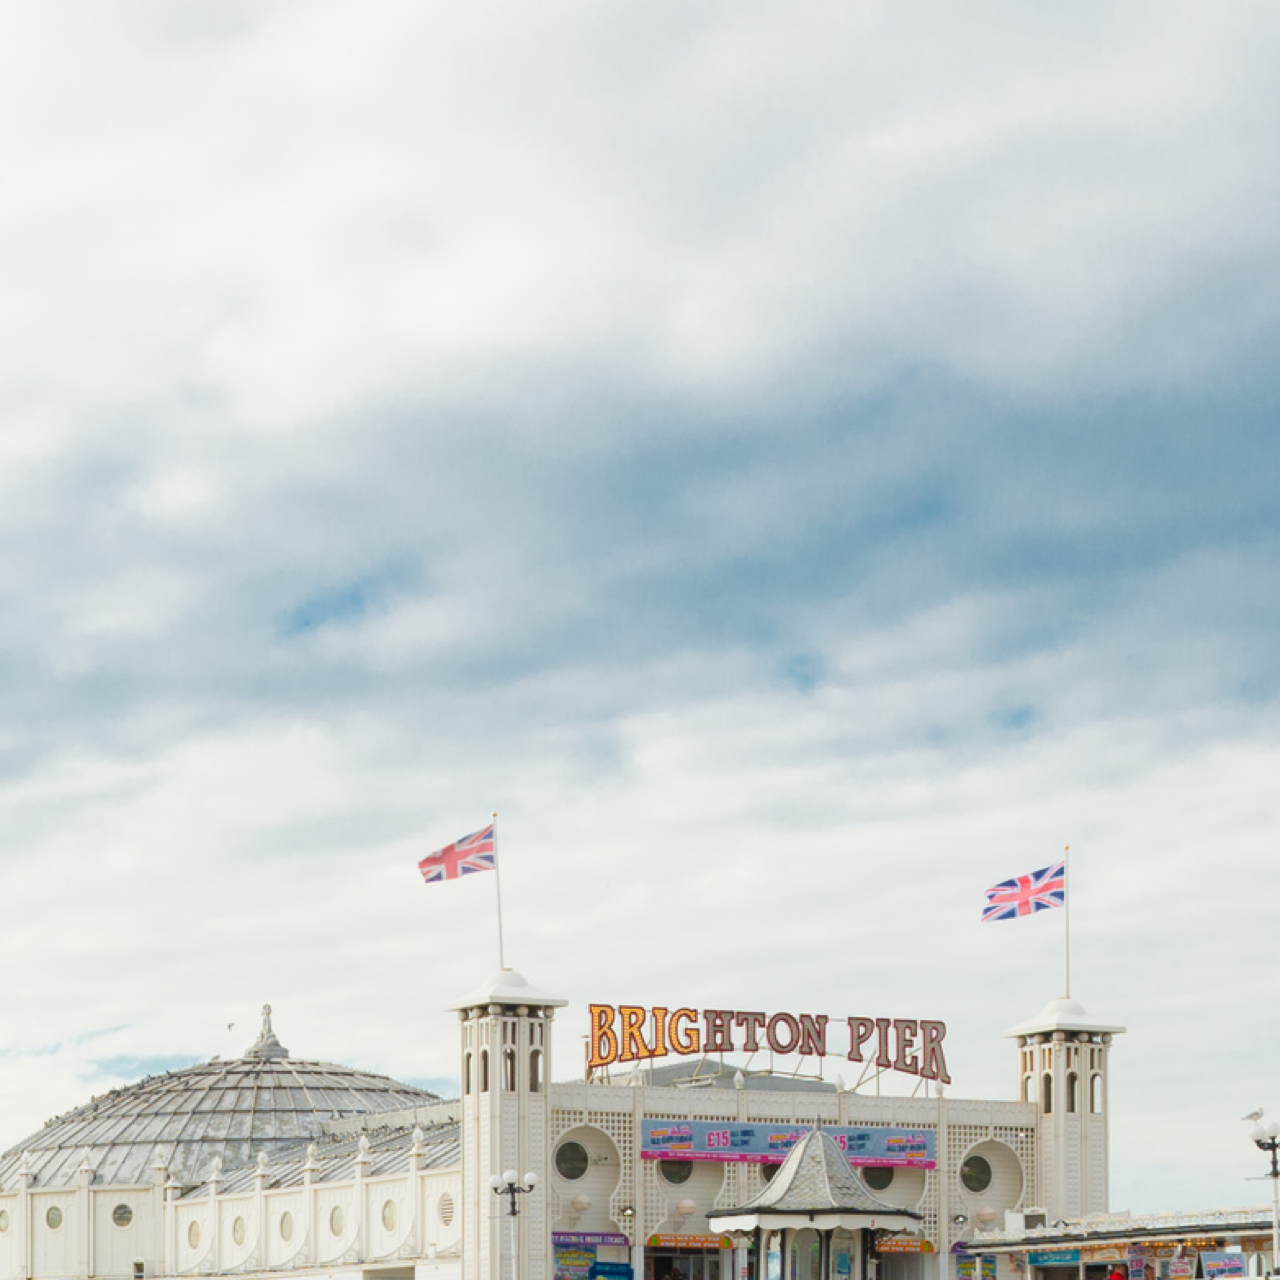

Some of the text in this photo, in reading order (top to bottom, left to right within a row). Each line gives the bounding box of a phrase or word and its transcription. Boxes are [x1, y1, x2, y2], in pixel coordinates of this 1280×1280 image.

[588, 1004, 952, 1084] BRIGHTON PIER
[707, 1130, 730, 1148] £15
